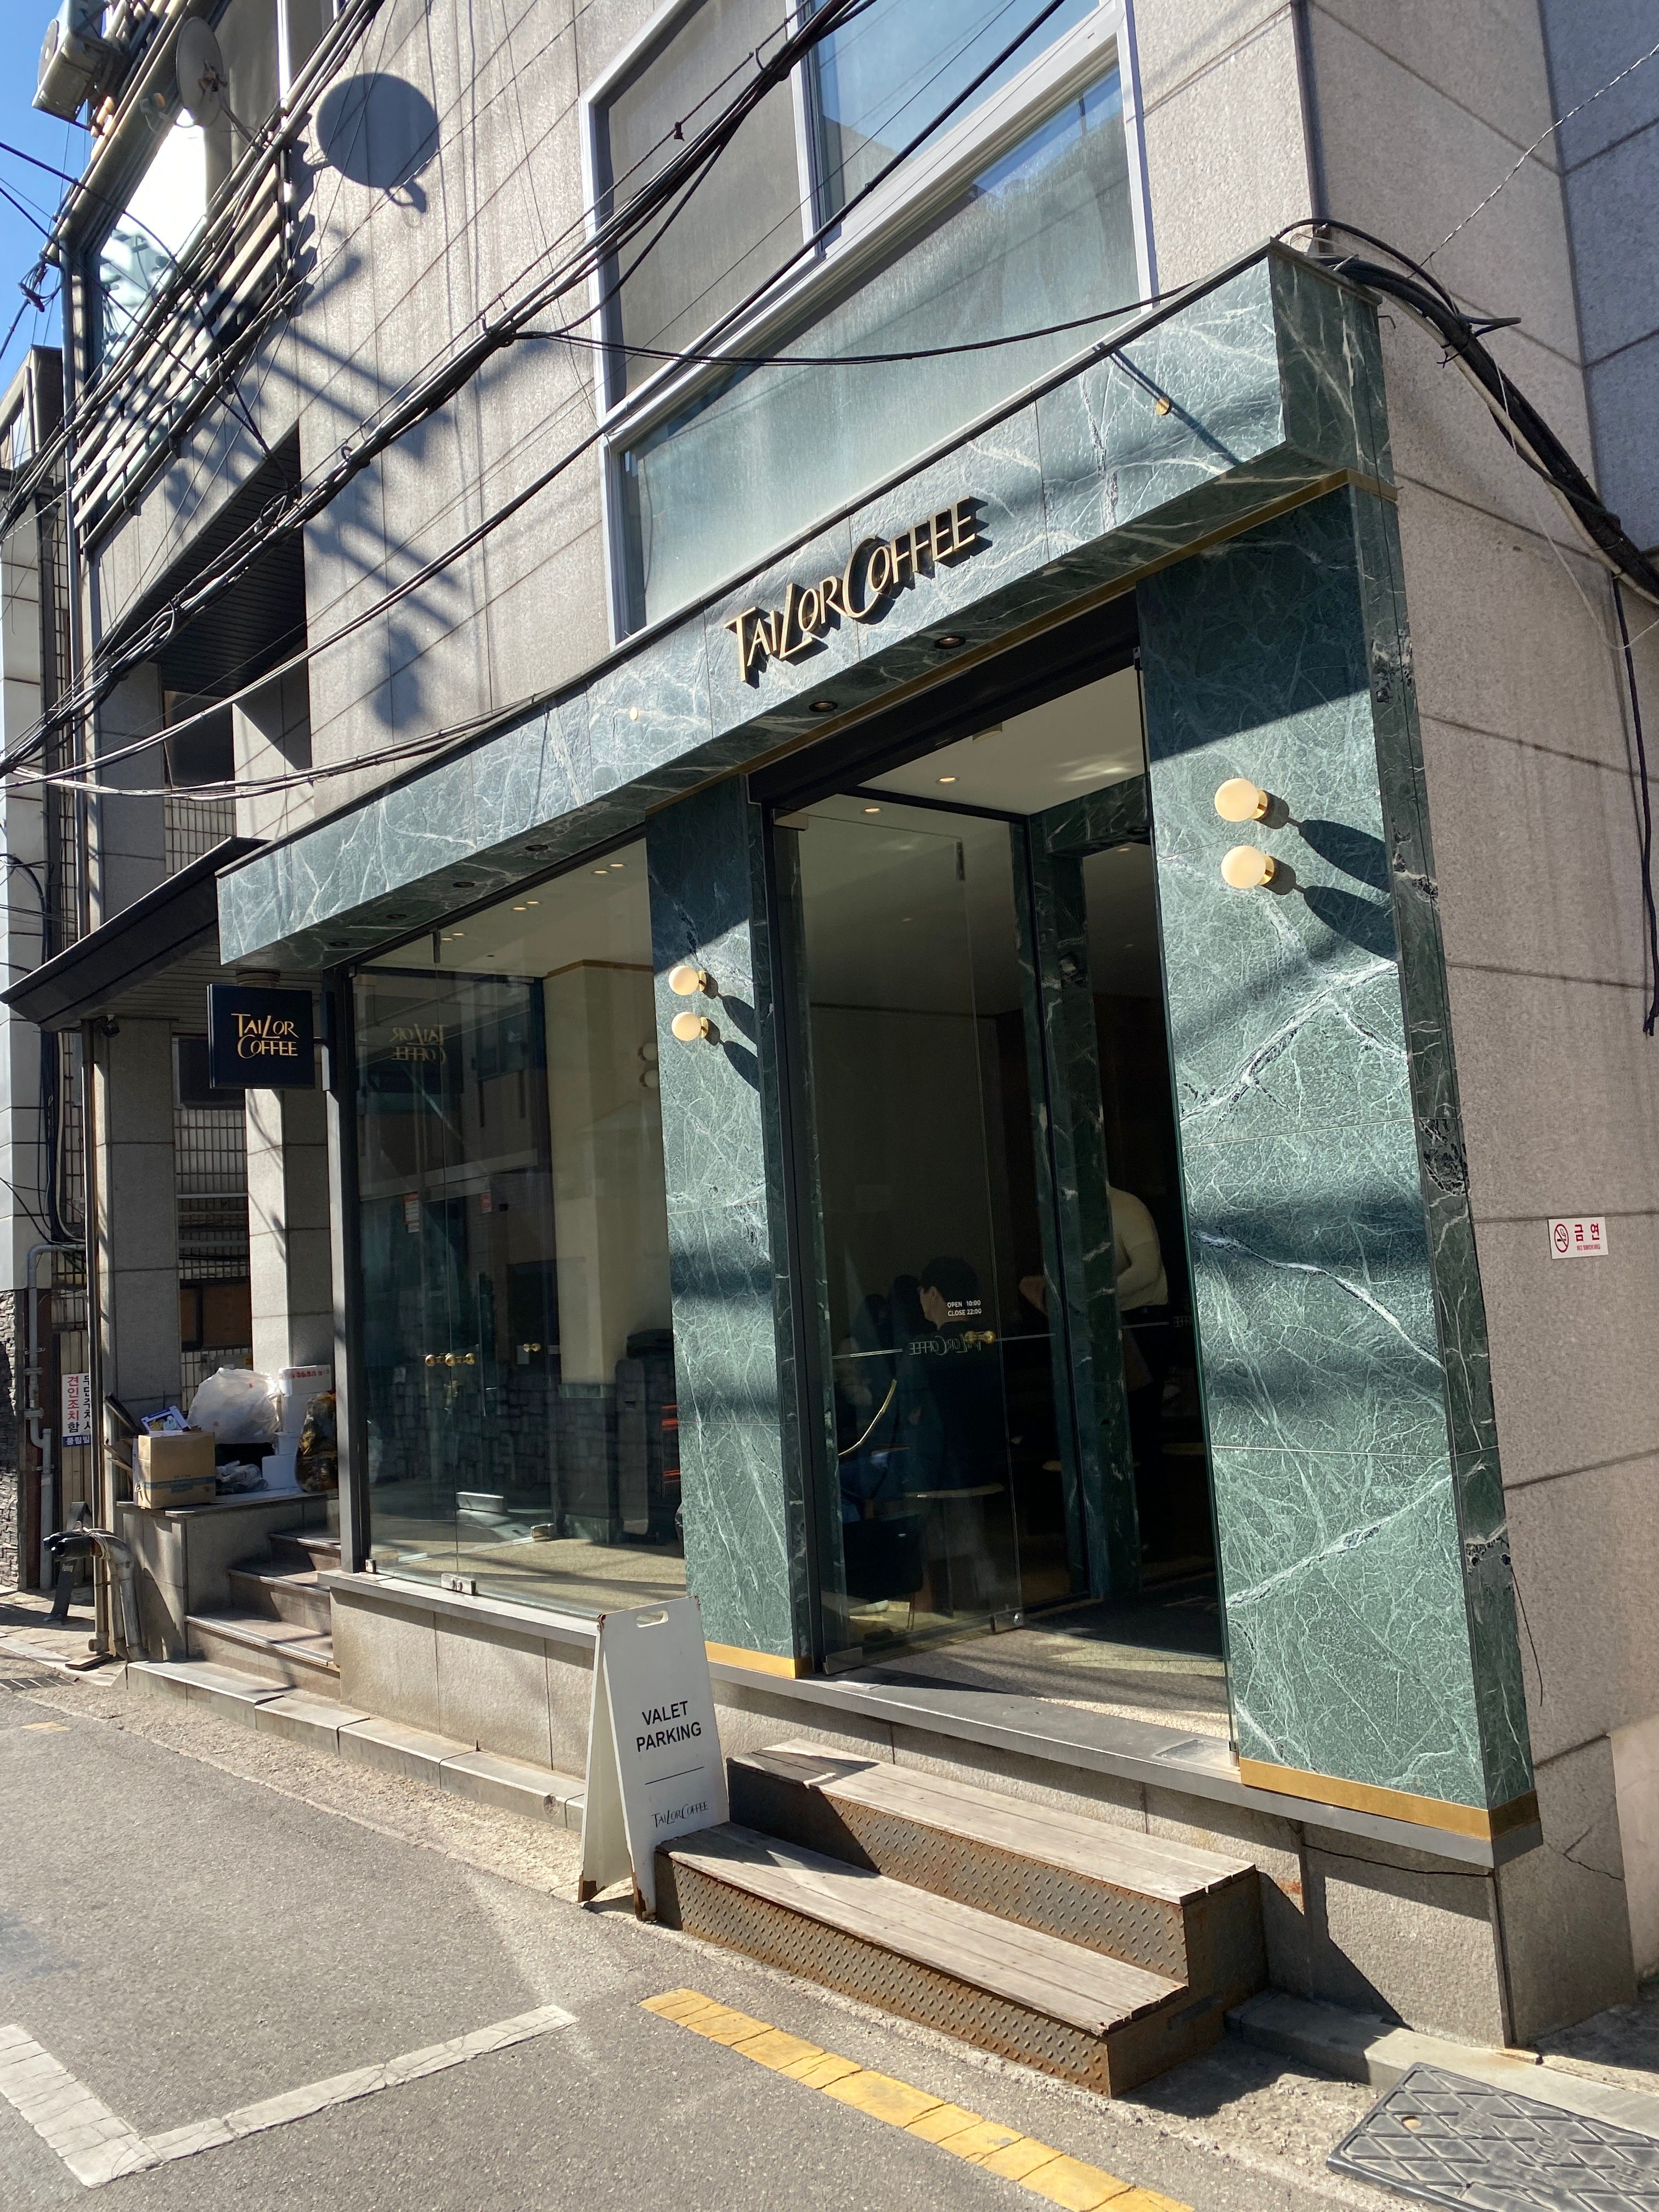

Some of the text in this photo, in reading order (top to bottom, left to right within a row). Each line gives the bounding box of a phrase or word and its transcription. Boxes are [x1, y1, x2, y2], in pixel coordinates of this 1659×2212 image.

[231, 1013, 298, 1039] TAILOR
[238, 1035, 298, 1059] COFFEE
[67, 1375, 80, 1433] 견인조치함
[641, 1700, 689, 1726] VALET
[636, 1722, 702, 1752] PARKING
